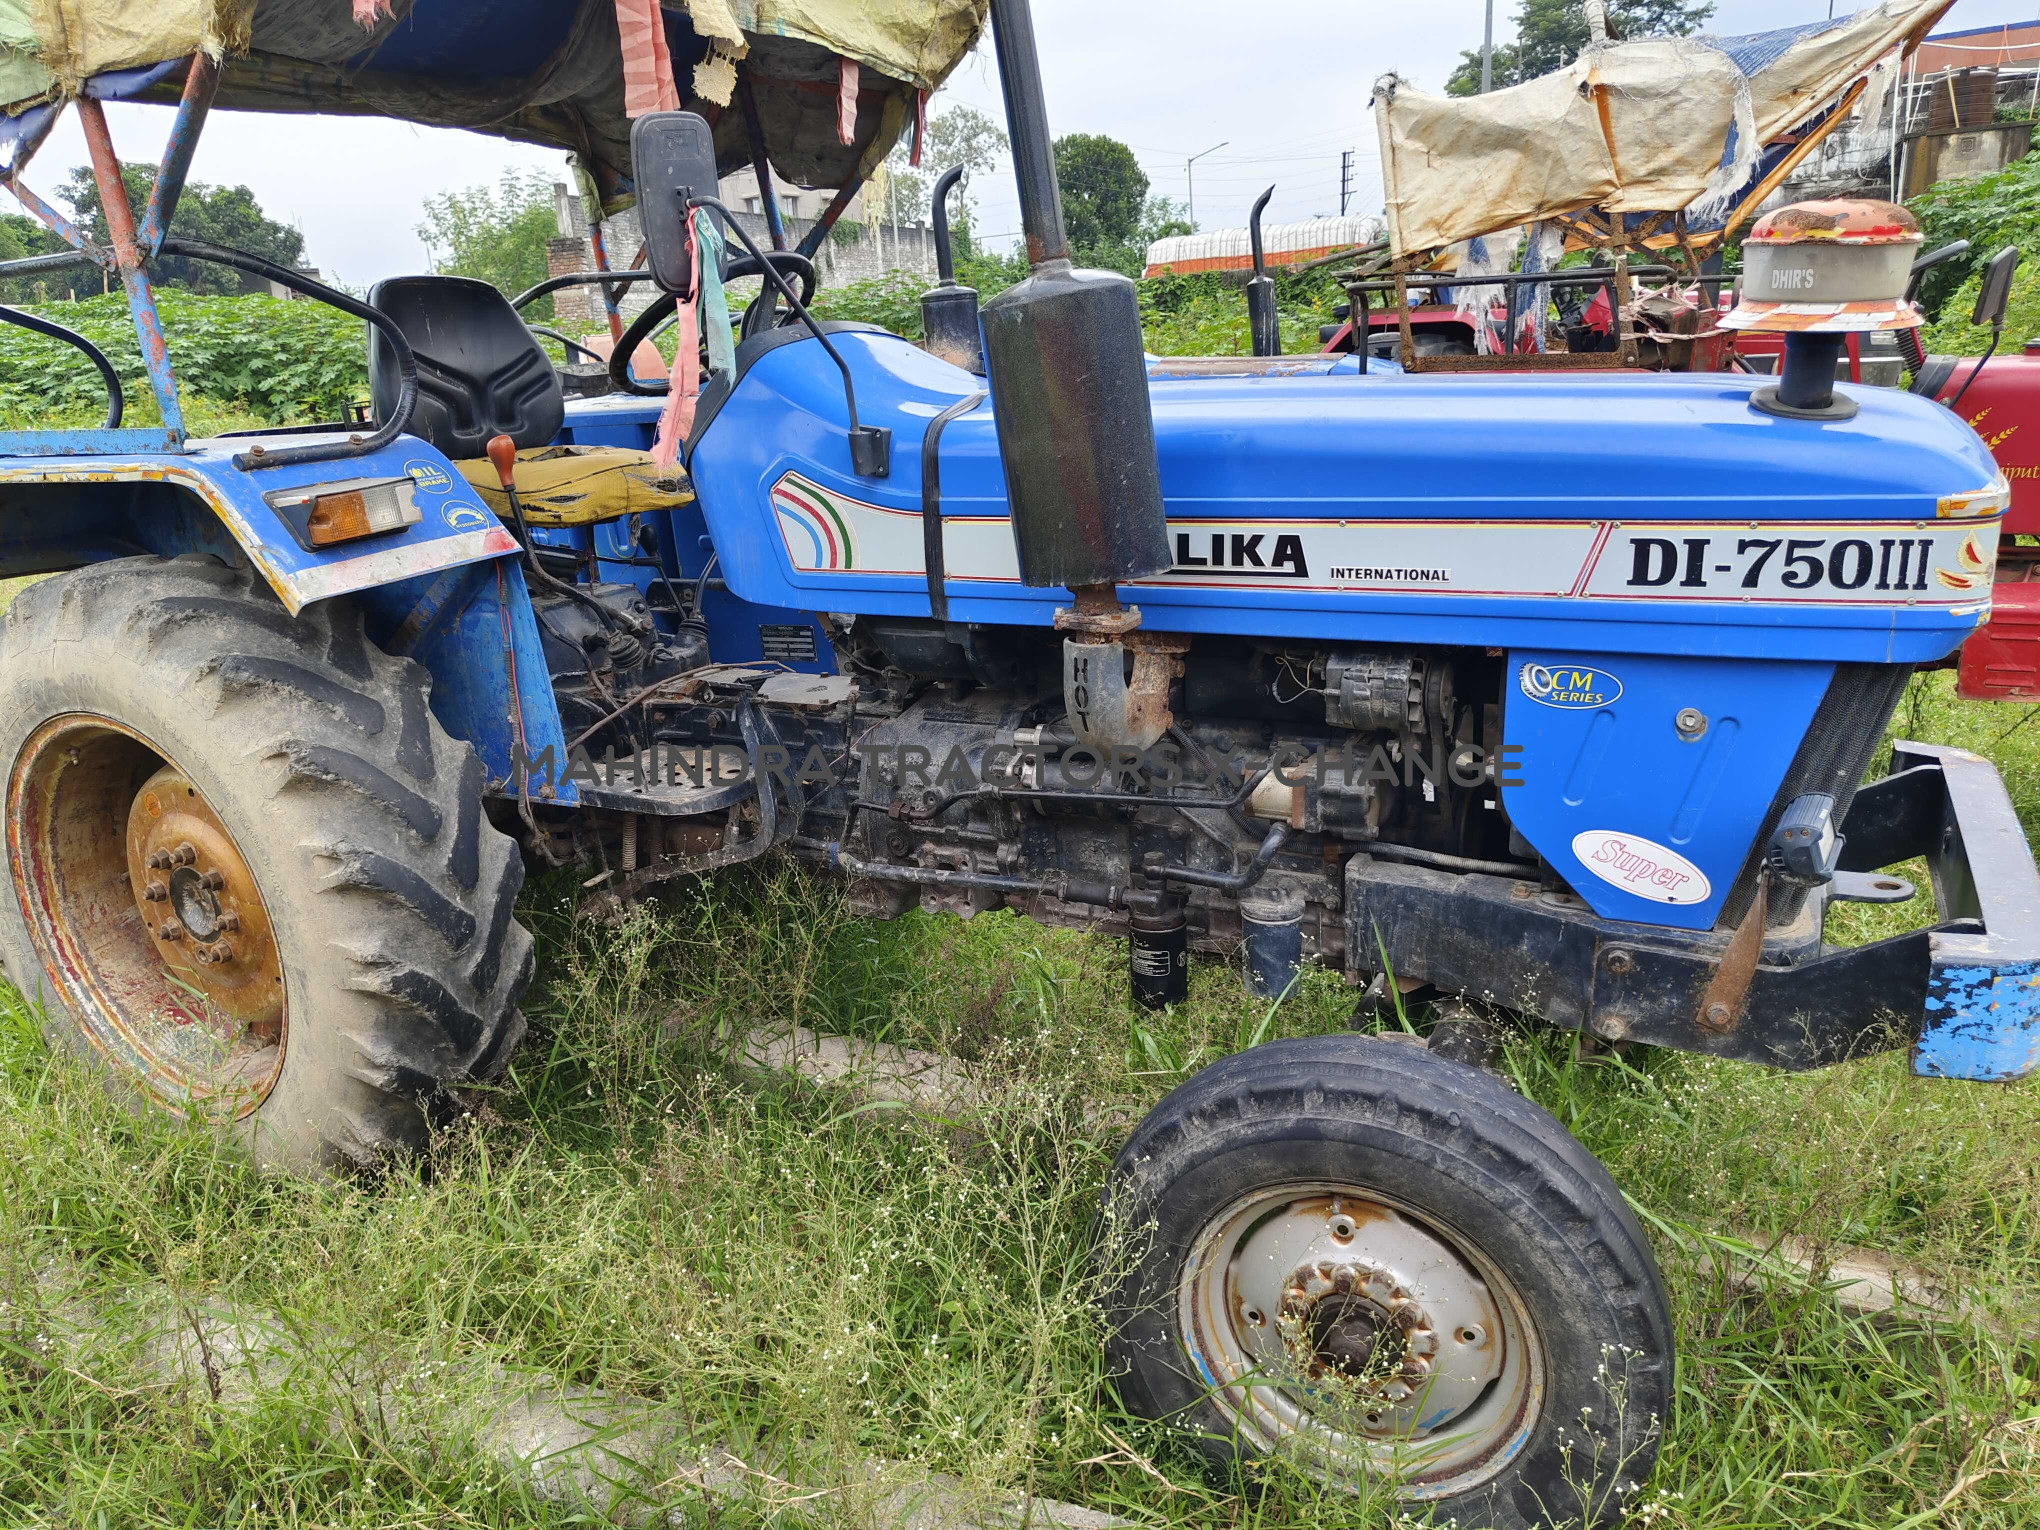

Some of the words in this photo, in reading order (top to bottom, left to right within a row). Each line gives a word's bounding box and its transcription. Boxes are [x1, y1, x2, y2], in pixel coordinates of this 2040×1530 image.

[1771, 269, 1814, 289] DHIR'S
[419, 478, 450, 488] BRAKE
[1168, 533, 1310, 578] LIKA
[1330, 567, 1450, 582] INTERNATIONAL
[1074, 657, 1090, 732] HOT
[1551, 691, 1603, 703] SERIES
[1591, 839, 1690, 890] Super
